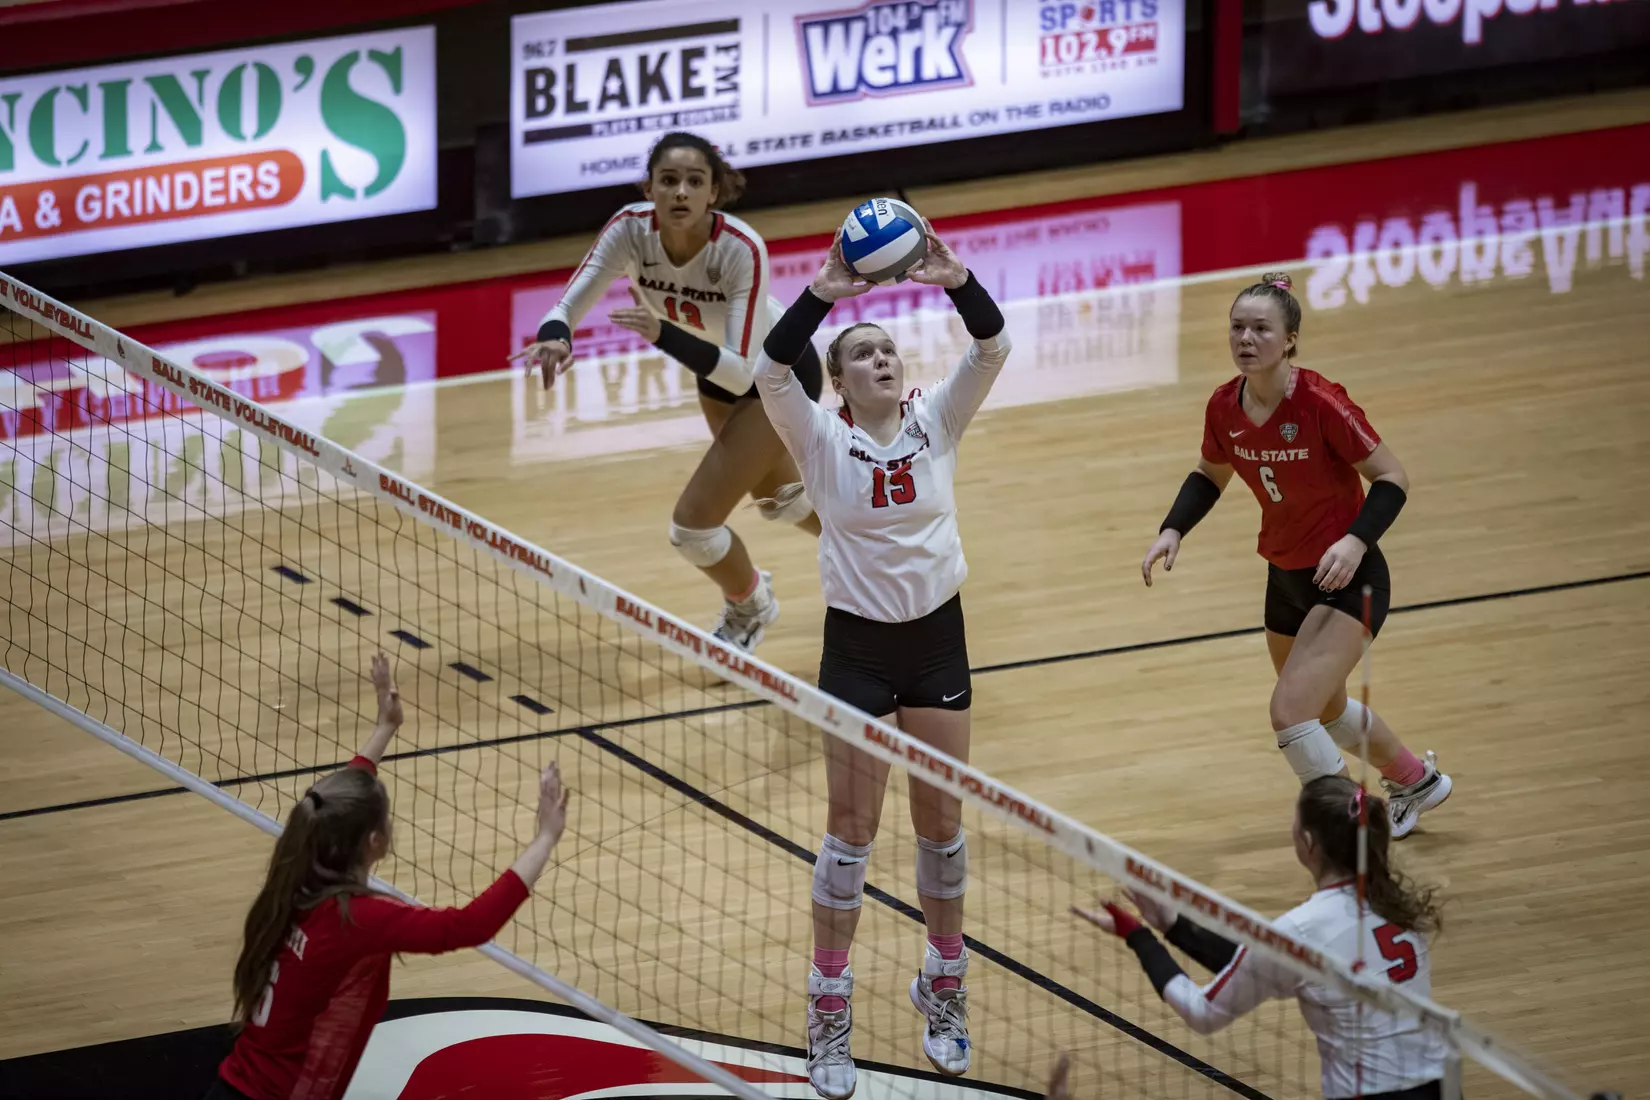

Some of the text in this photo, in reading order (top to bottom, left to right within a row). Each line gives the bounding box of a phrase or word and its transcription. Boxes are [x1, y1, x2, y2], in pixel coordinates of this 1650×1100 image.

[524, 45, 706, 122] BLAKE
[805, 10, 960, 95] Werk
[0, 46, 407, 204] CINO'S
[580, 156, 641, 175] HOME
[746, 133, 814, 155] STATE
[821, 112, 963, 145] BASKETBALL
[968, 109, 999, 127] ON
[1005, 103, 1043, 121] THE
[1049, 93, 1111, 115] RADIO
[35, 190, 62, 229] &
[75, 160, 281, 223] GRINDERS
[12, 283, 95, 341] VOLLEYBALL
[639, 275, 679, 294] BALL
[151, 356, 185, 389] BALL
[188, 375, 231, 412] STATE
[232, 398, 320, 457] VOLLEYBALL
[871, 460, 917, 508] 15
[1234, 445, 1309, 463] BALL STATE
[1258, 465, 1285, 503] 6
[379, 472, 554, 579] BALL STATE VOLLEYBALL
[615, 595, 800, 704] BALL STATE VOLLEYBALL
[863, 722, 1057, 835] BALL STATE VOLLEYBALL
[1371, 922, 1419, 985] 5
